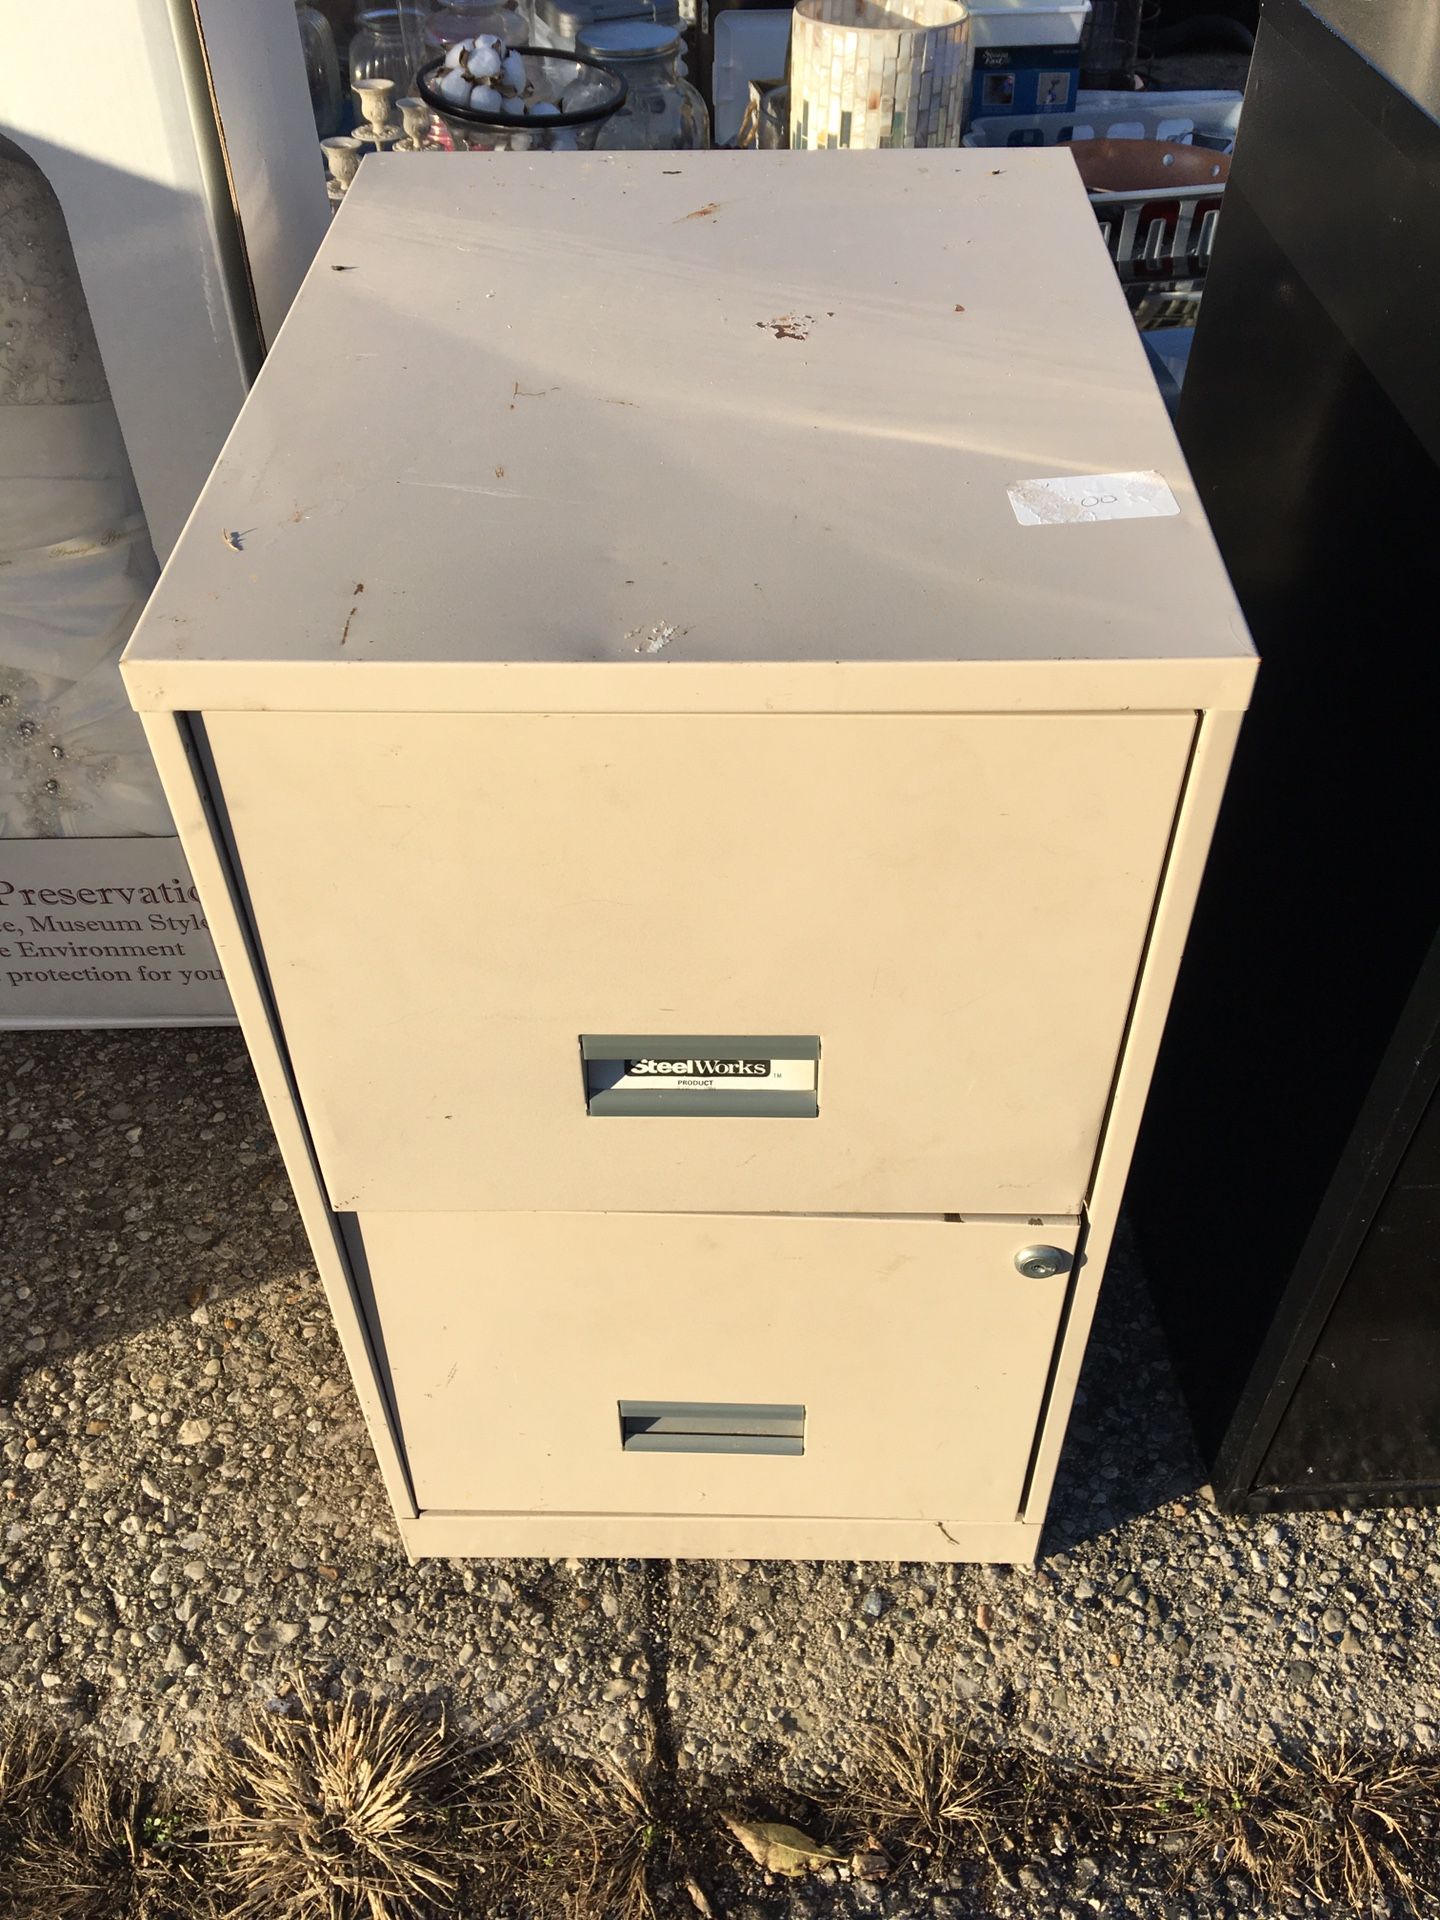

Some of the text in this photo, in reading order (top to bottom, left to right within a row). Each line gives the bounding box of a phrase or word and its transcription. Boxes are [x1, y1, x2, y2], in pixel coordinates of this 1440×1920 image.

[25, 915, 143, 933] Museum
[14, 941, 187, 958] Environment
[6, 965, 226, 987] protection for you
[677, 1079, 714, 1087] PRODUCT
